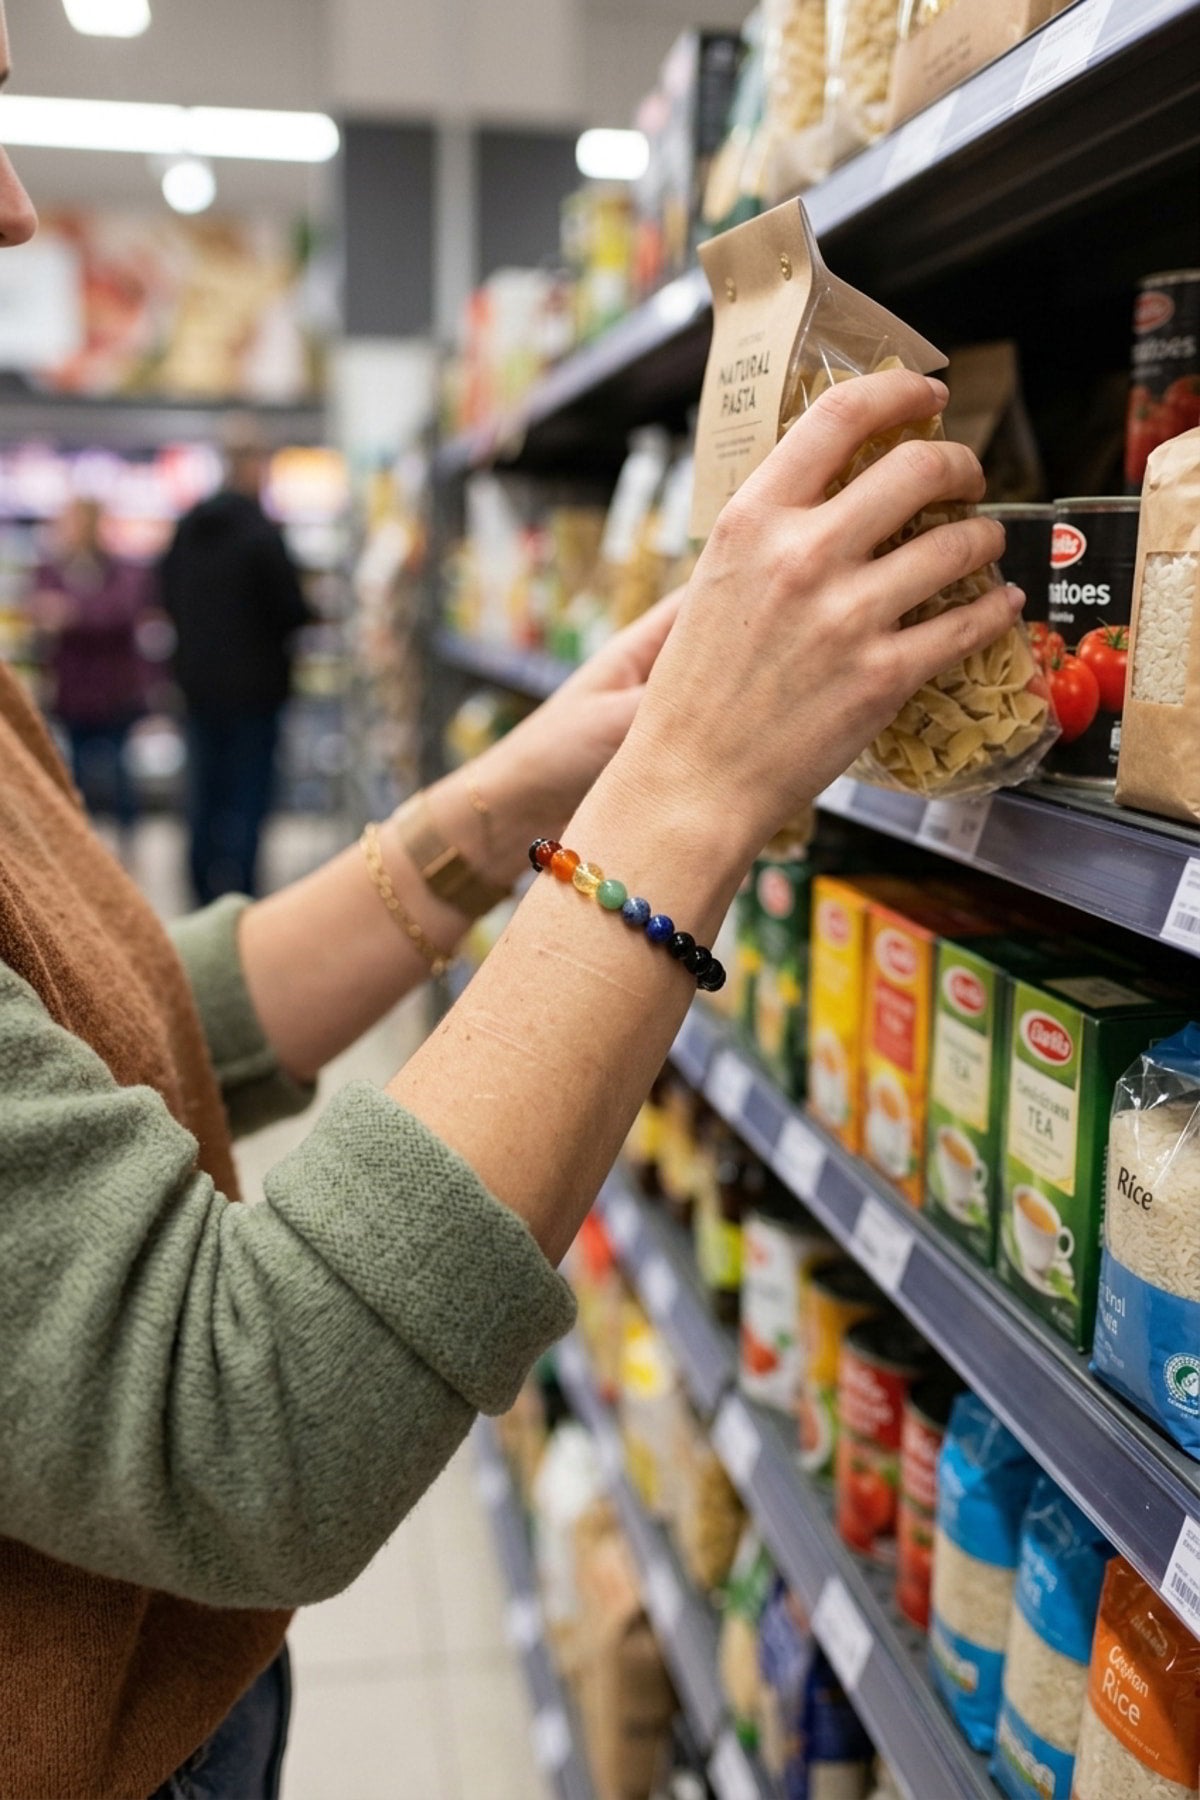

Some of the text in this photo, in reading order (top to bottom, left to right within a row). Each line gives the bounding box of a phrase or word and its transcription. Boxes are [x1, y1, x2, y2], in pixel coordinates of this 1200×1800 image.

[718, 351, 770, 386] NATURAL
[721, 387, 756, 417] PASTA
[1028, 1106, 1054, 1141] TEA
[1117, 1166, 1153, 1211] Rice
[1102, 1667, 1142, 1727] Rice
